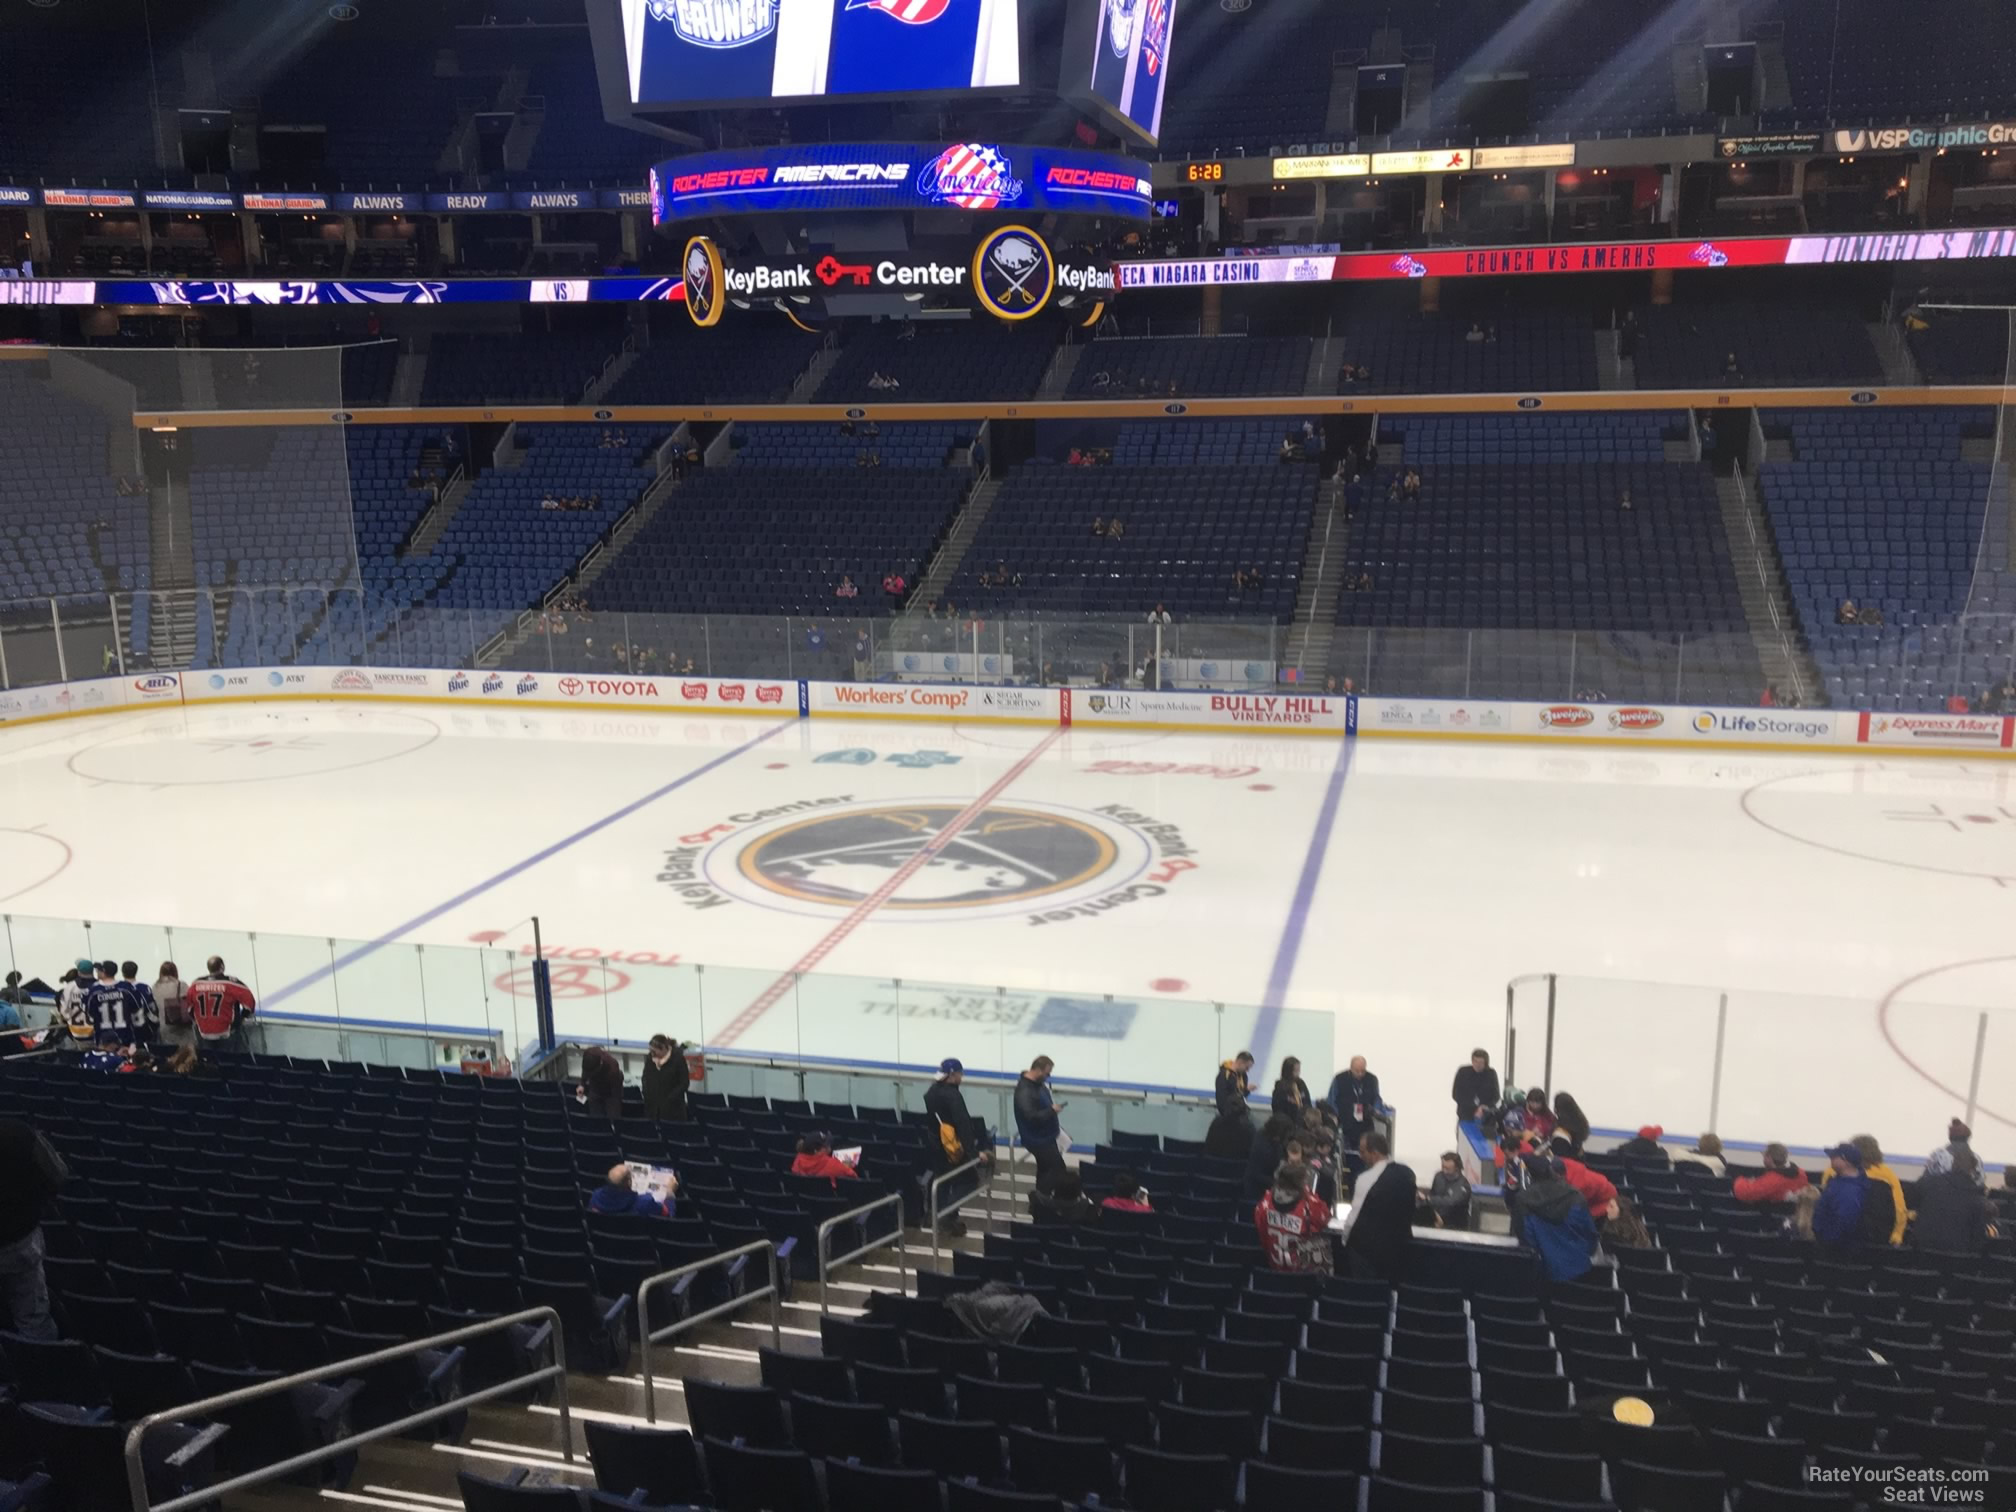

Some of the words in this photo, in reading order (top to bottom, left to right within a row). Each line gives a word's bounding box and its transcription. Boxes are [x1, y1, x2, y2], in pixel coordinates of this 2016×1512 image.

[676, 0, 770, 42] CRUNCH
[673, 168, 768, 192] ROCHESTER
[774, 164, 910, 183] AMERICANS
[1047, 168, 1136, 190] ROCHESTER
[1189, 164, 1222, 180] 6:28
[45, 195, 89, 204] NATIONAL
[90, 196, 120, 205] GUARD
[146, 195, 232, 206] NATIONALGUARD.com
[353, 196, 404, 209] ALWAYS
[447, 196, 486, 208] READY
[531, 195, 578, 207] ALWAYS
[1466, 251, 1534, 273] CRUNCH
[1549, 249, 1568, 270] VS
[724, 267, 812, 294] KeyBank
[876, 261, 966, 285] Center
[1058, 265, 1115, 290] KeyBank
[1153, 263, 1206, 284] NIAGARA
[1214, 262, 1260, 282] CASINO
[552, 281, 567, 301] VS
[144, 679, 170, 691] AHL
[228, 676, 248, 686] AT&T
[286, 675, 305, 683] AT&T
[448, 679, 469, 692] Blue
[482, 680, 503, 693] Blue
[517, 681, 538, 695] Blue
[587, 680, 658, 697] TOYOTA
[835, 687, 908, 705] Workers'
[911, 688, 969, 710] Comp?
[1107, 695, 1131, 710] UR
[1211, 695, 1278, 712] BULLY
[1285, 696, 1333, 714] HILL
[1140, 701, 1165, 713] Sports
[1231, 712, 1312, 723] VINEYARDS
[1956, 720, 1999, 731] Mart
[196, 992, 224, 1018] 17
[99, 1001, 127, 1030] 11
